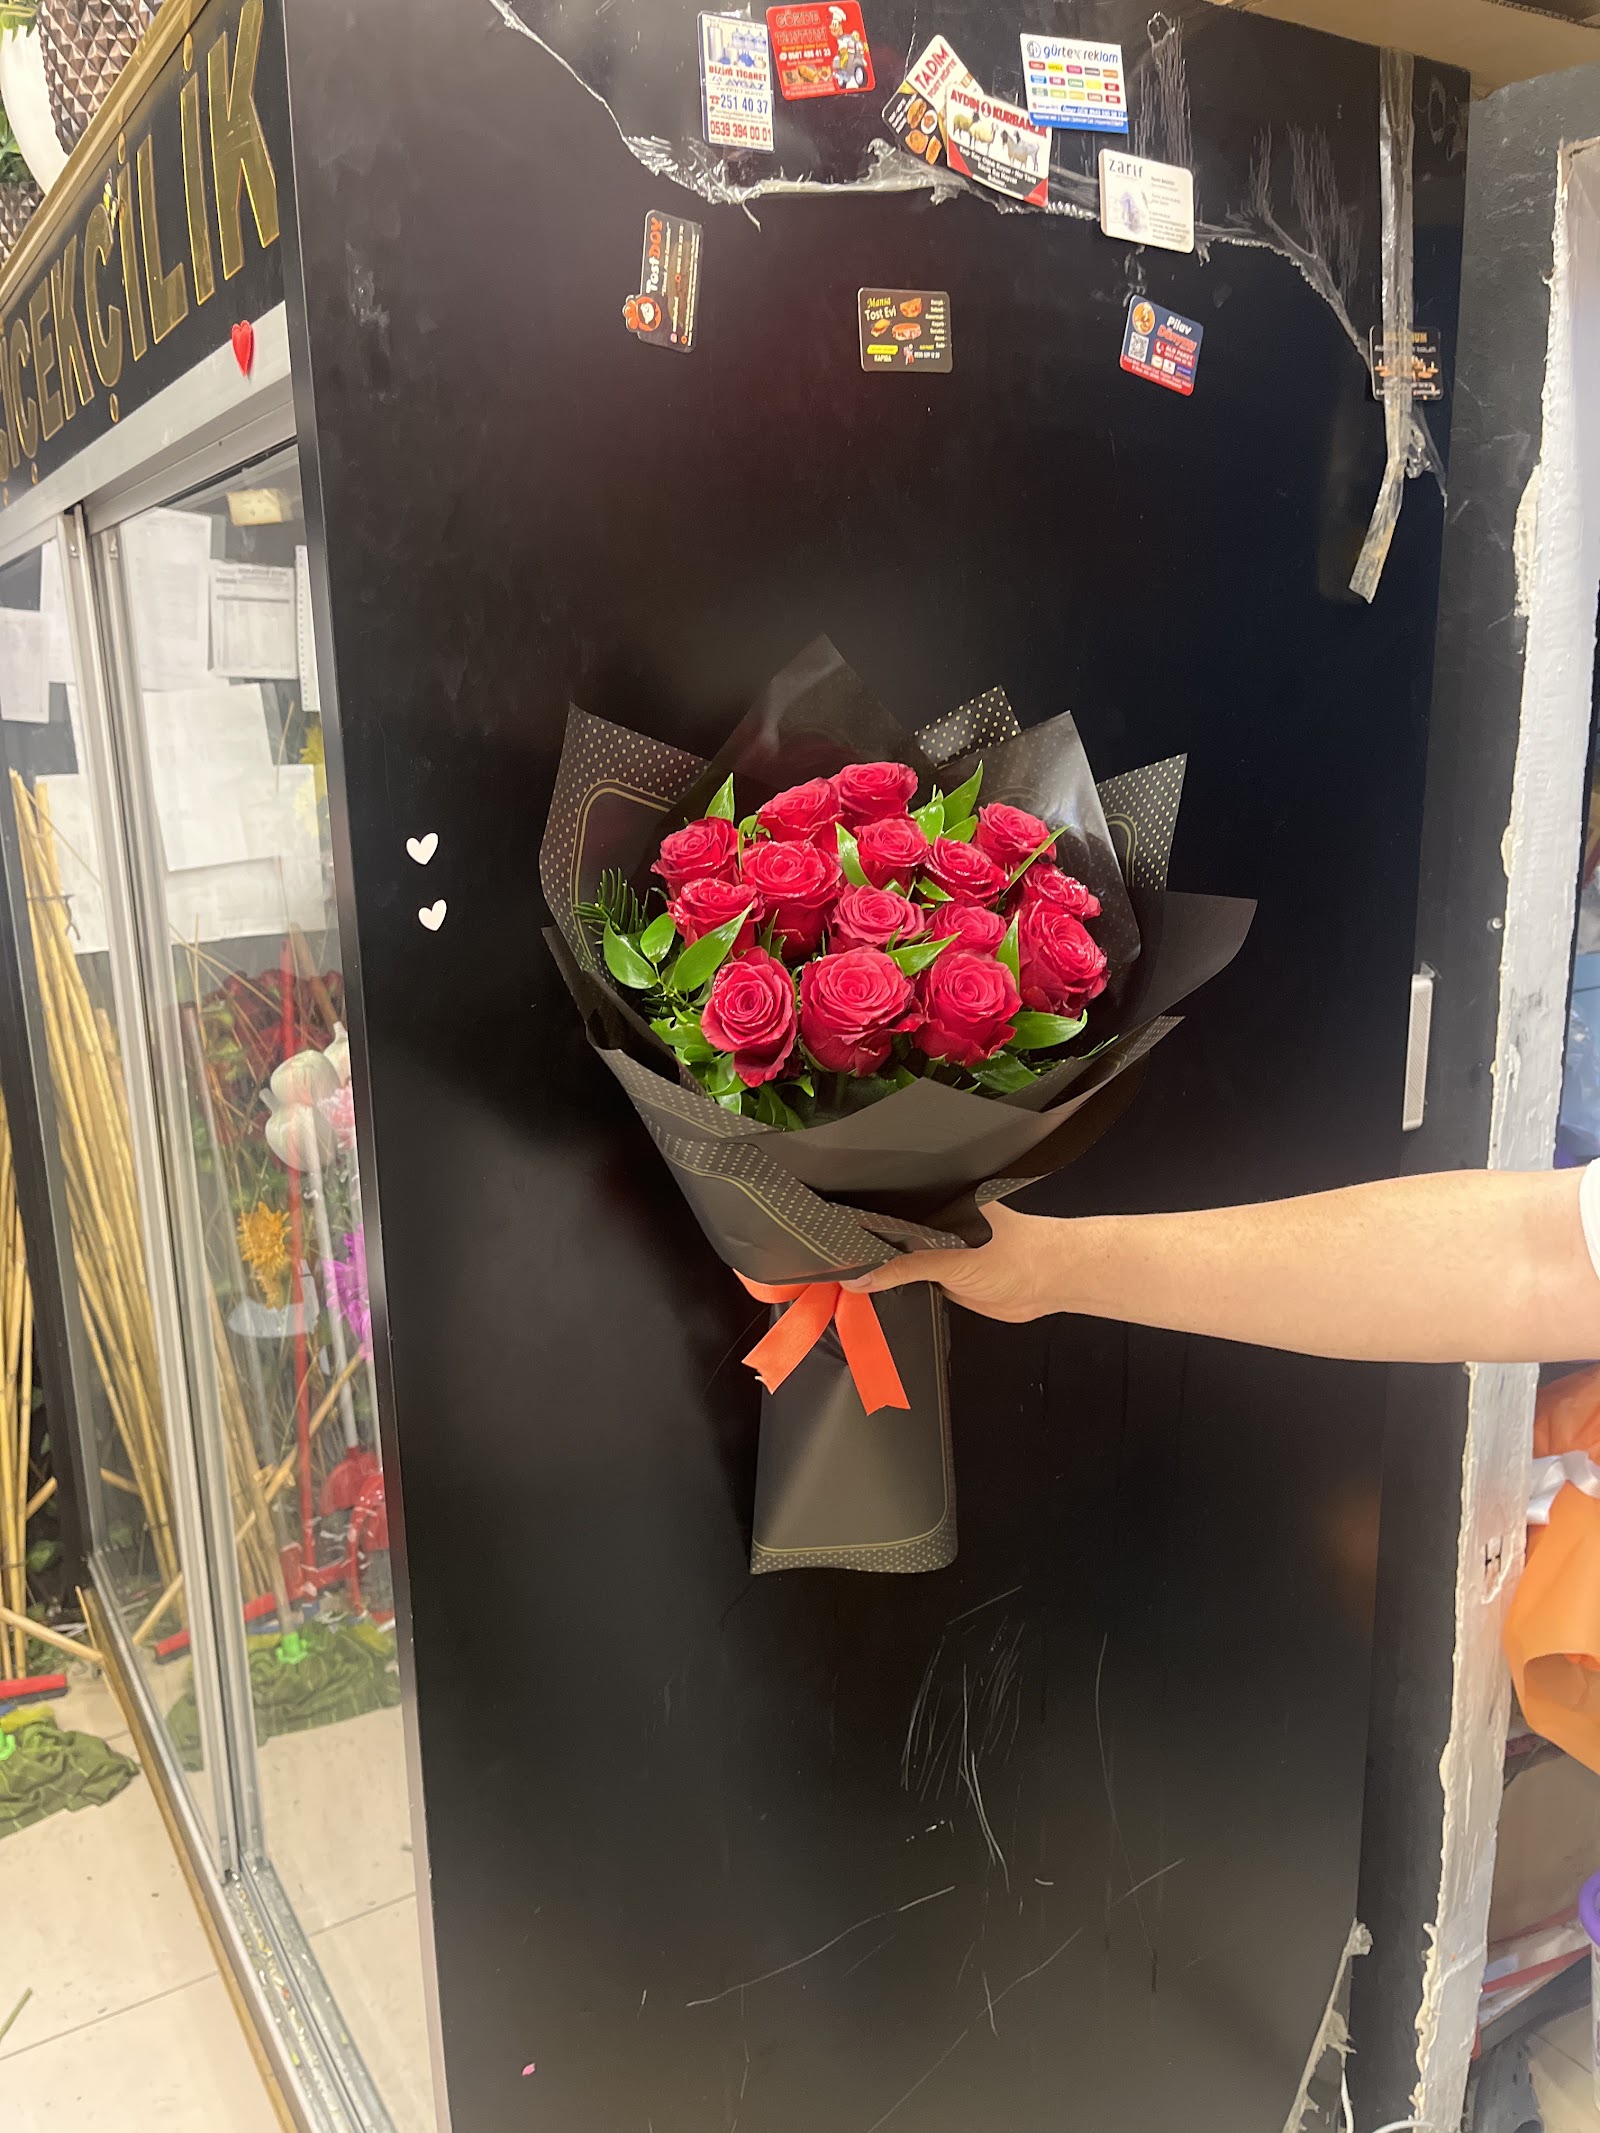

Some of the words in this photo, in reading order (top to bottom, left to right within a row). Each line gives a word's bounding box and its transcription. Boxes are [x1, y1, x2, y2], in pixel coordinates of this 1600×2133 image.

[776, 8, 821, 28] GÖZDE
[1083, 49, 1119, 64] reklam
[709, 65, 733, 77] BİZİM
[914, 43, 950, 91] TADIM
[720, 94, 738, 110] 251
[742, 96, 754, 112] 40
[757, 99, 768, 114] 37
[950, 88, 980, 113] AYDIN
[710, 120, 731, 136] 0539
[732, 122, 748, 138] 394
[750, 125, 760, 140] 00
[762, 127, 772, 142] 01
[864, 309, 884, 322] Tost
[884, 305, 897, 318] Evi
[1166, 315, 1192, 336] Pilav
